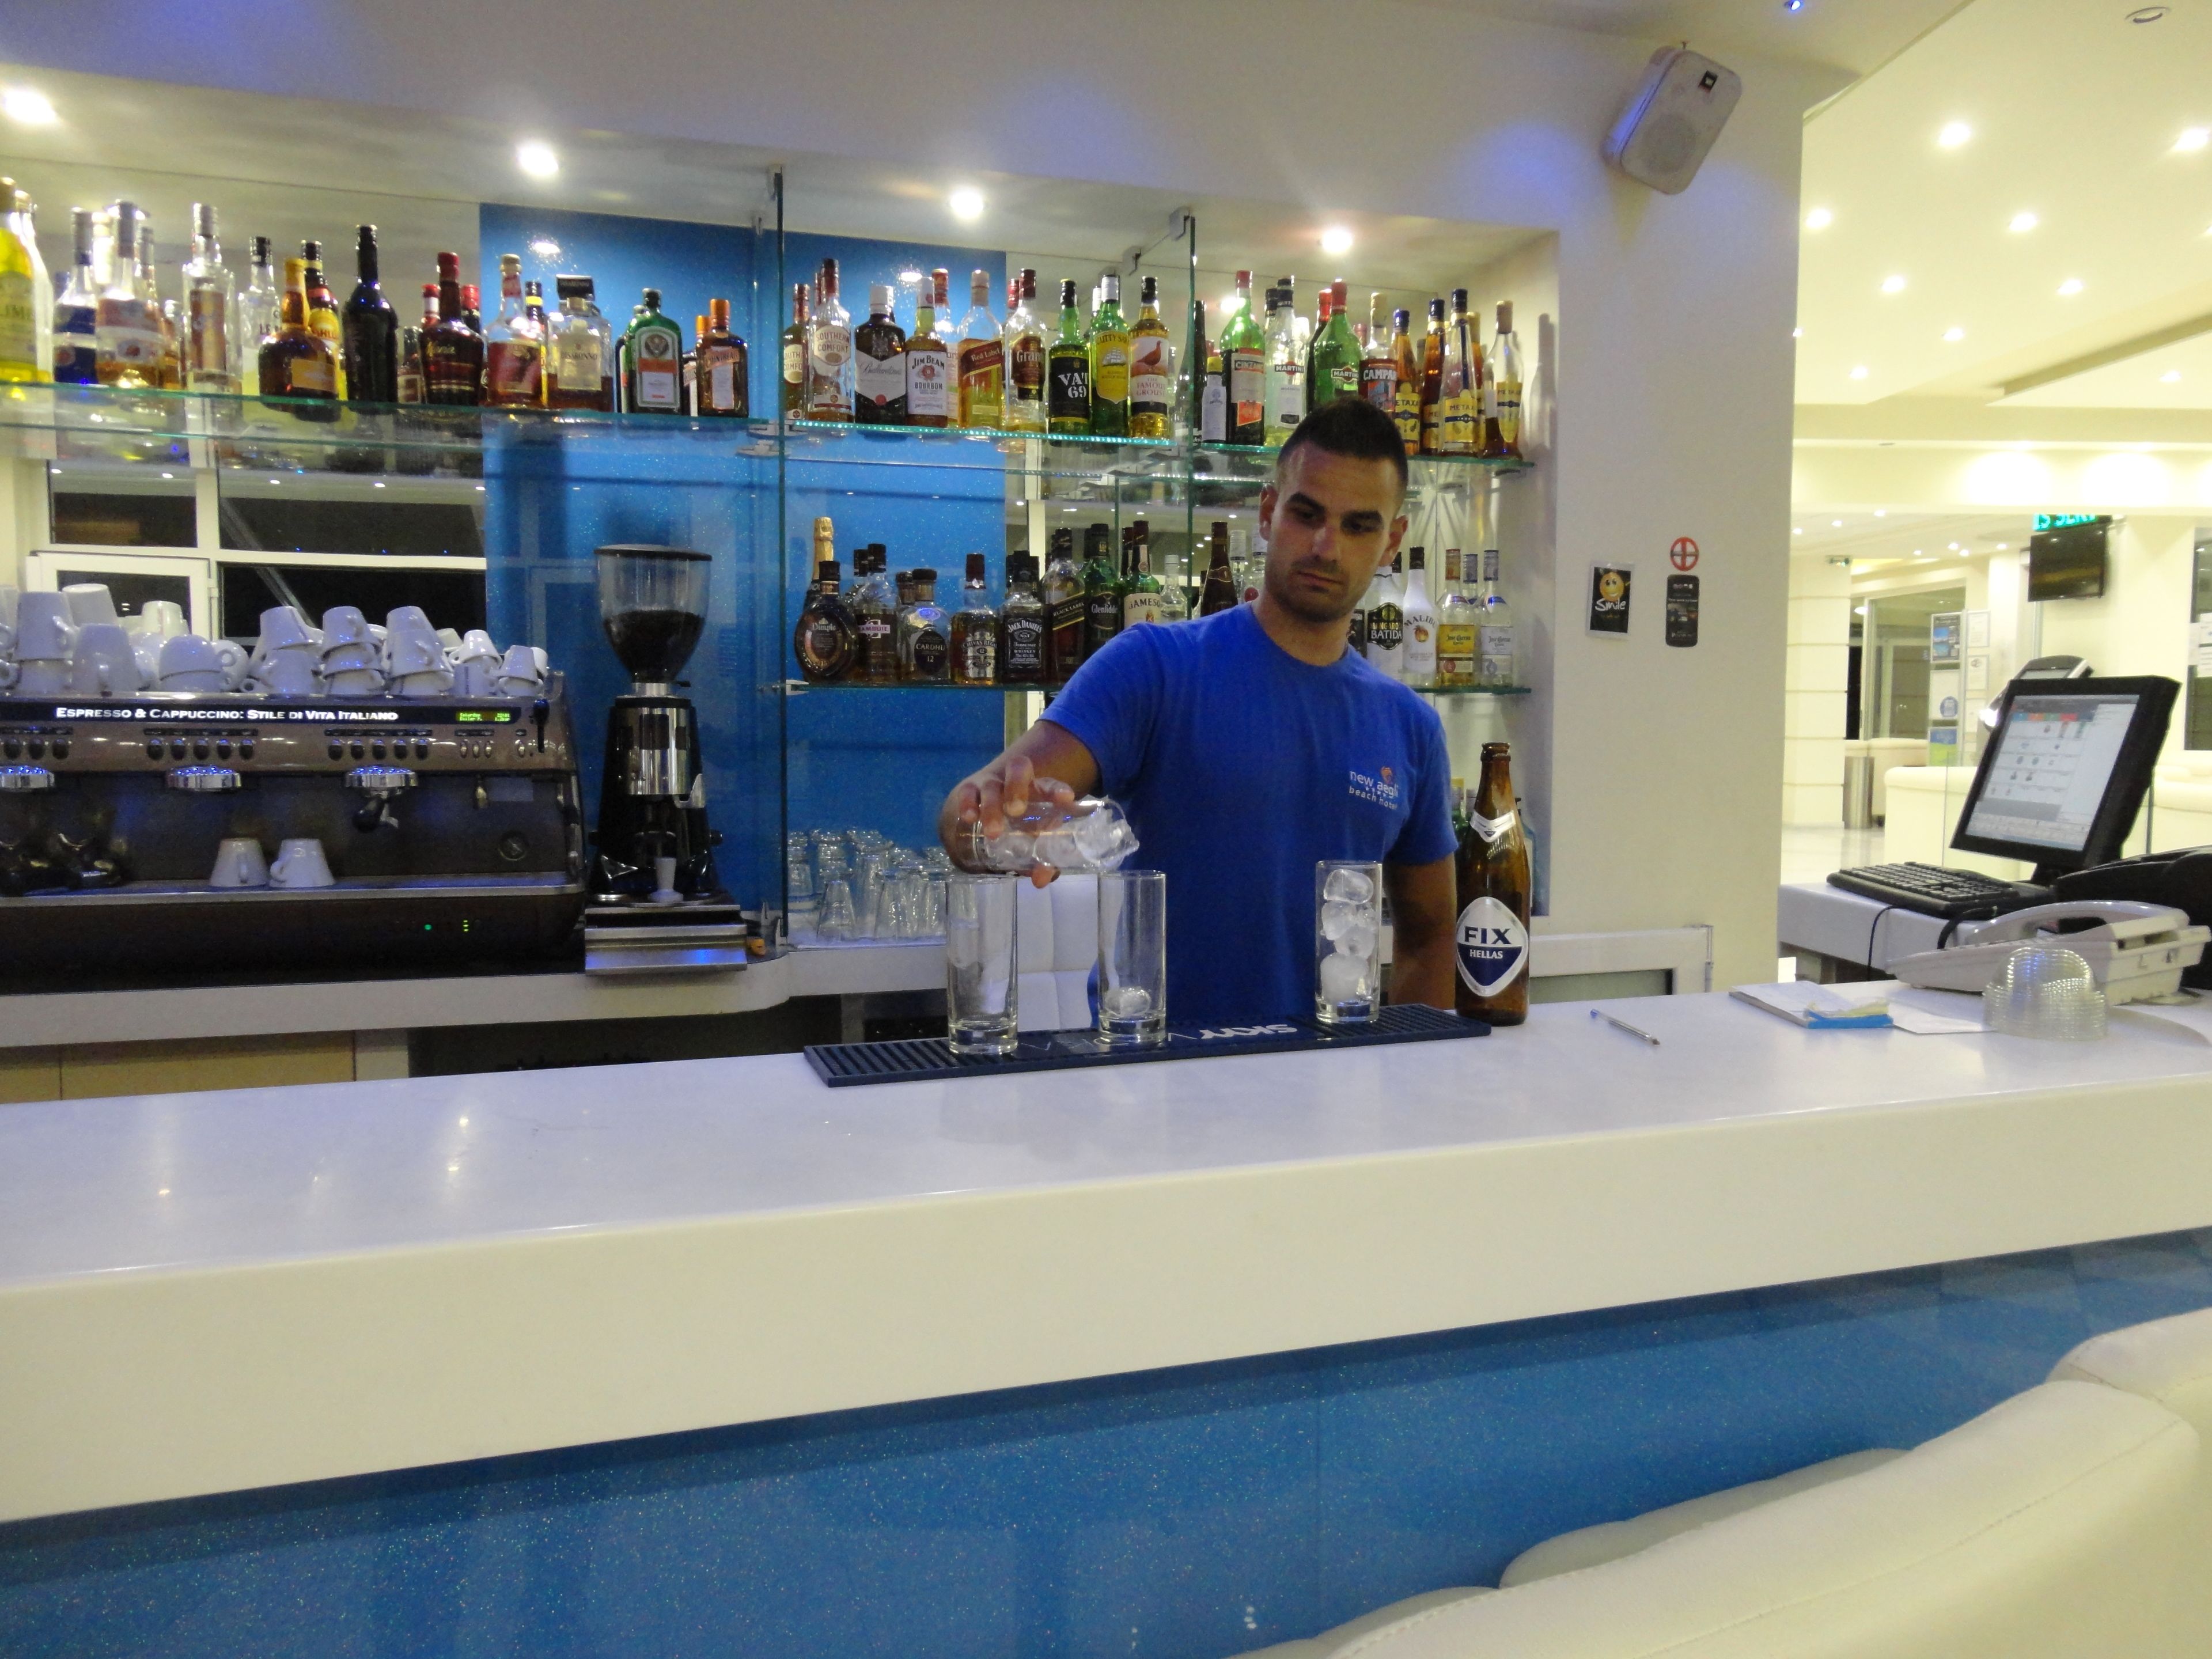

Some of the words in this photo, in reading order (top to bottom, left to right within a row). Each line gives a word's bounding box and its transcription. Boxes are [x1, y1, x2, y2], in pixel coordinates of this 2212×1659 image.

[816, 331, 850, 343] SOUTHERN
[817, 345, 849, 353] COMFORT
[971, 353, 984, 362] Red
[984, 347, 1001, 358] Label
[912, 358, 925, 369] JIM
[926, 355, 945, 370] BEAM
[914, 382, 943, 390] BOURBON
[1067, 385, 1086, 398] 69
[1052, 605, 1070, 617] BLACK
[1594, 597, 1627, 612] Smile
[1007, 622, 1022, 633] JACK
[1371, 630, 1403, 639] BATIDA
[916, 643, 945, 651] CARDHU
[56, 707, 132, 719] ESPRESSO
[134, 708, 146, 719] &
[247, 709, 286, 719] STILE
[304, 710, 336, 720] VITA
[338, 710, 398, 721] ITALIANO
[1350, 770, 1374, 787] new
[1377, 781, 1399, 799] aegli
[1349, 785, 1377, 802] beach
[1464, 926, 1512, 945] FIX
[1469, 949, 1503, 959] HELLAS
[1200, 1024, 1298, 1040] SKYY
